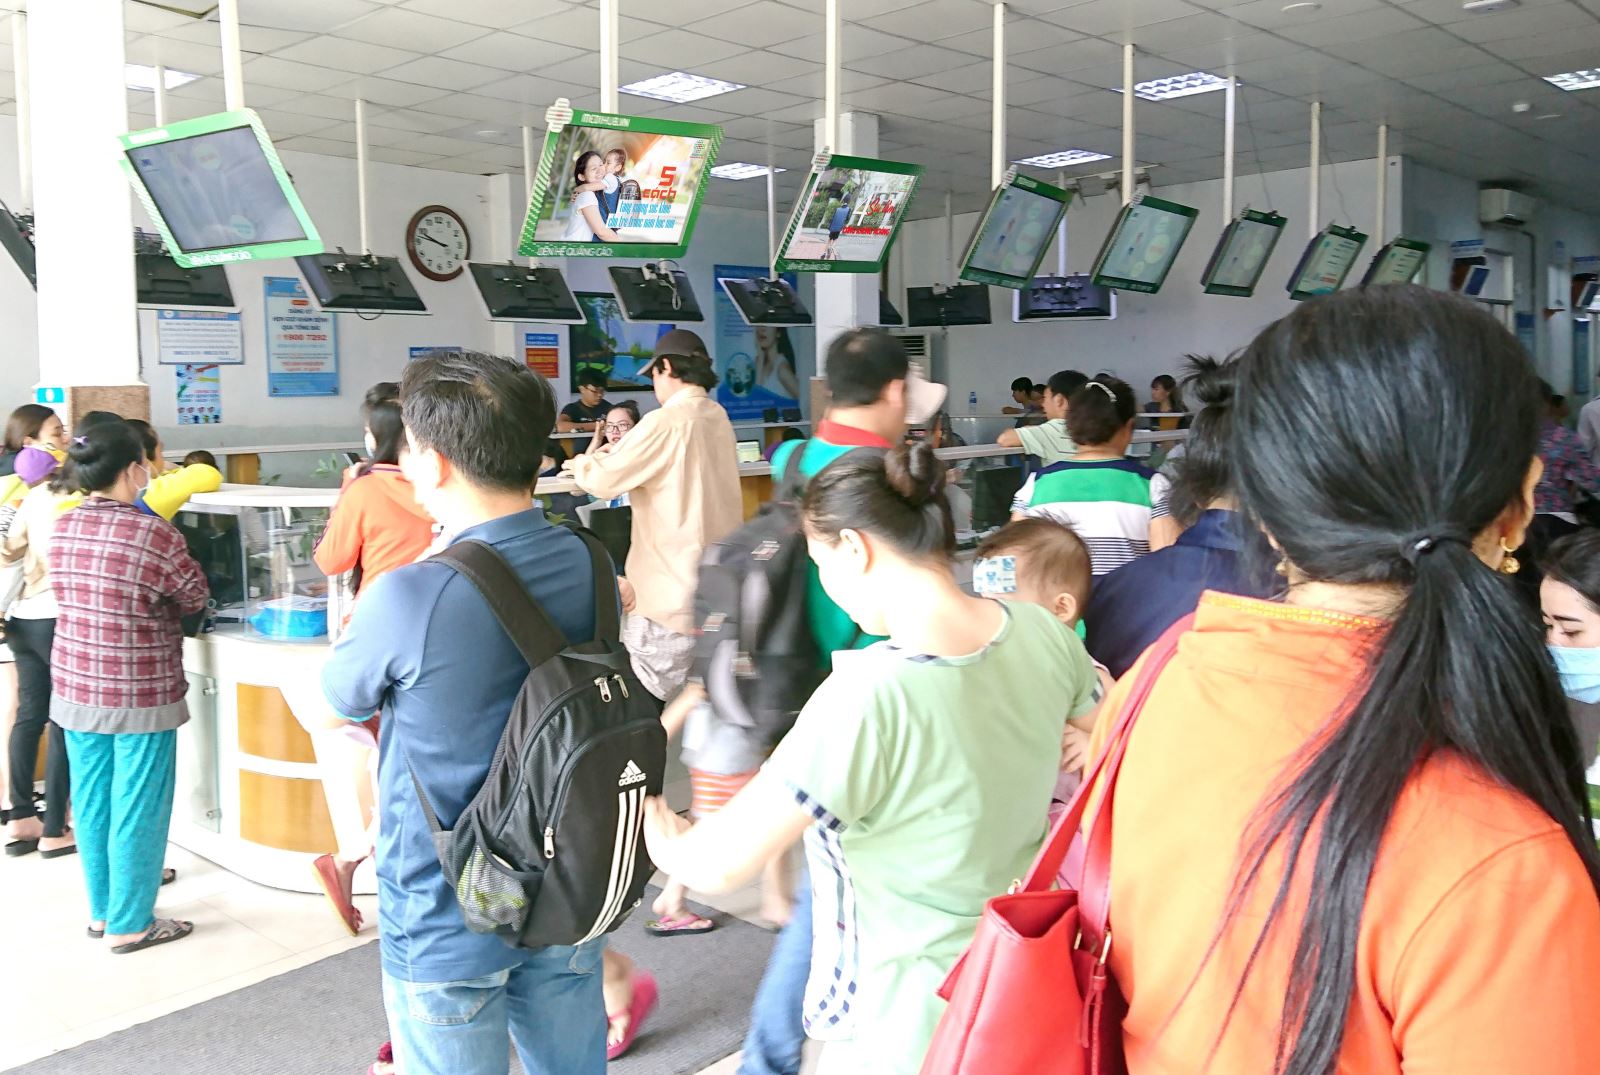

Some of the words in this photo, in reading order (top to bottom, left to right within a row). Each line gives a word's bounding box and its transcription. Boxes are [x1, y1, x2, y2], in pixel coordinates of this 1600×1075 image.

[658, 165, 678, 186] 5
[853, 192, 874, 226] 4
[618, 772, 647, 786] adidas
